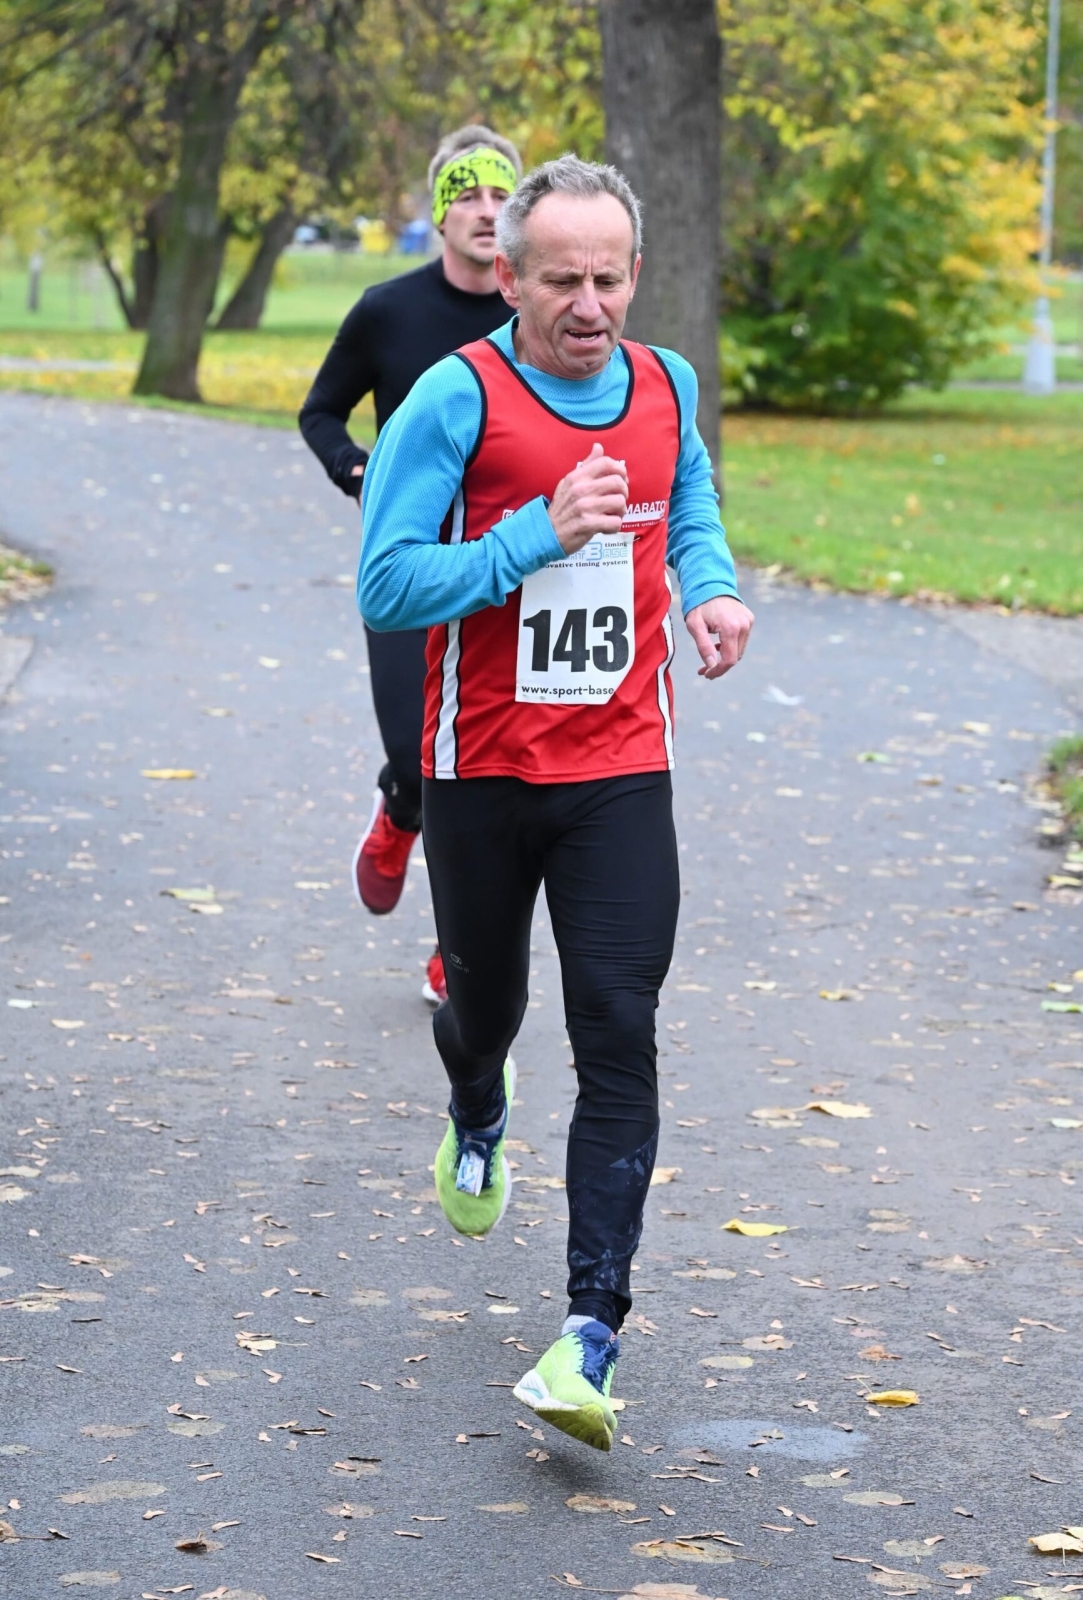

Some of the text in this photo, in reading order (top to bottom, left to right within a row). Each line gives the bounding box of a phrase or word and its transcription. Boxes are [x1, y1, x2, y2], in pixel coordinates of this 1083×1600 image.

[625, 500, 667, 514] MARATO
[523, 605, 629, 673] 143
[521, 685, 614, 698] www.sport-base
